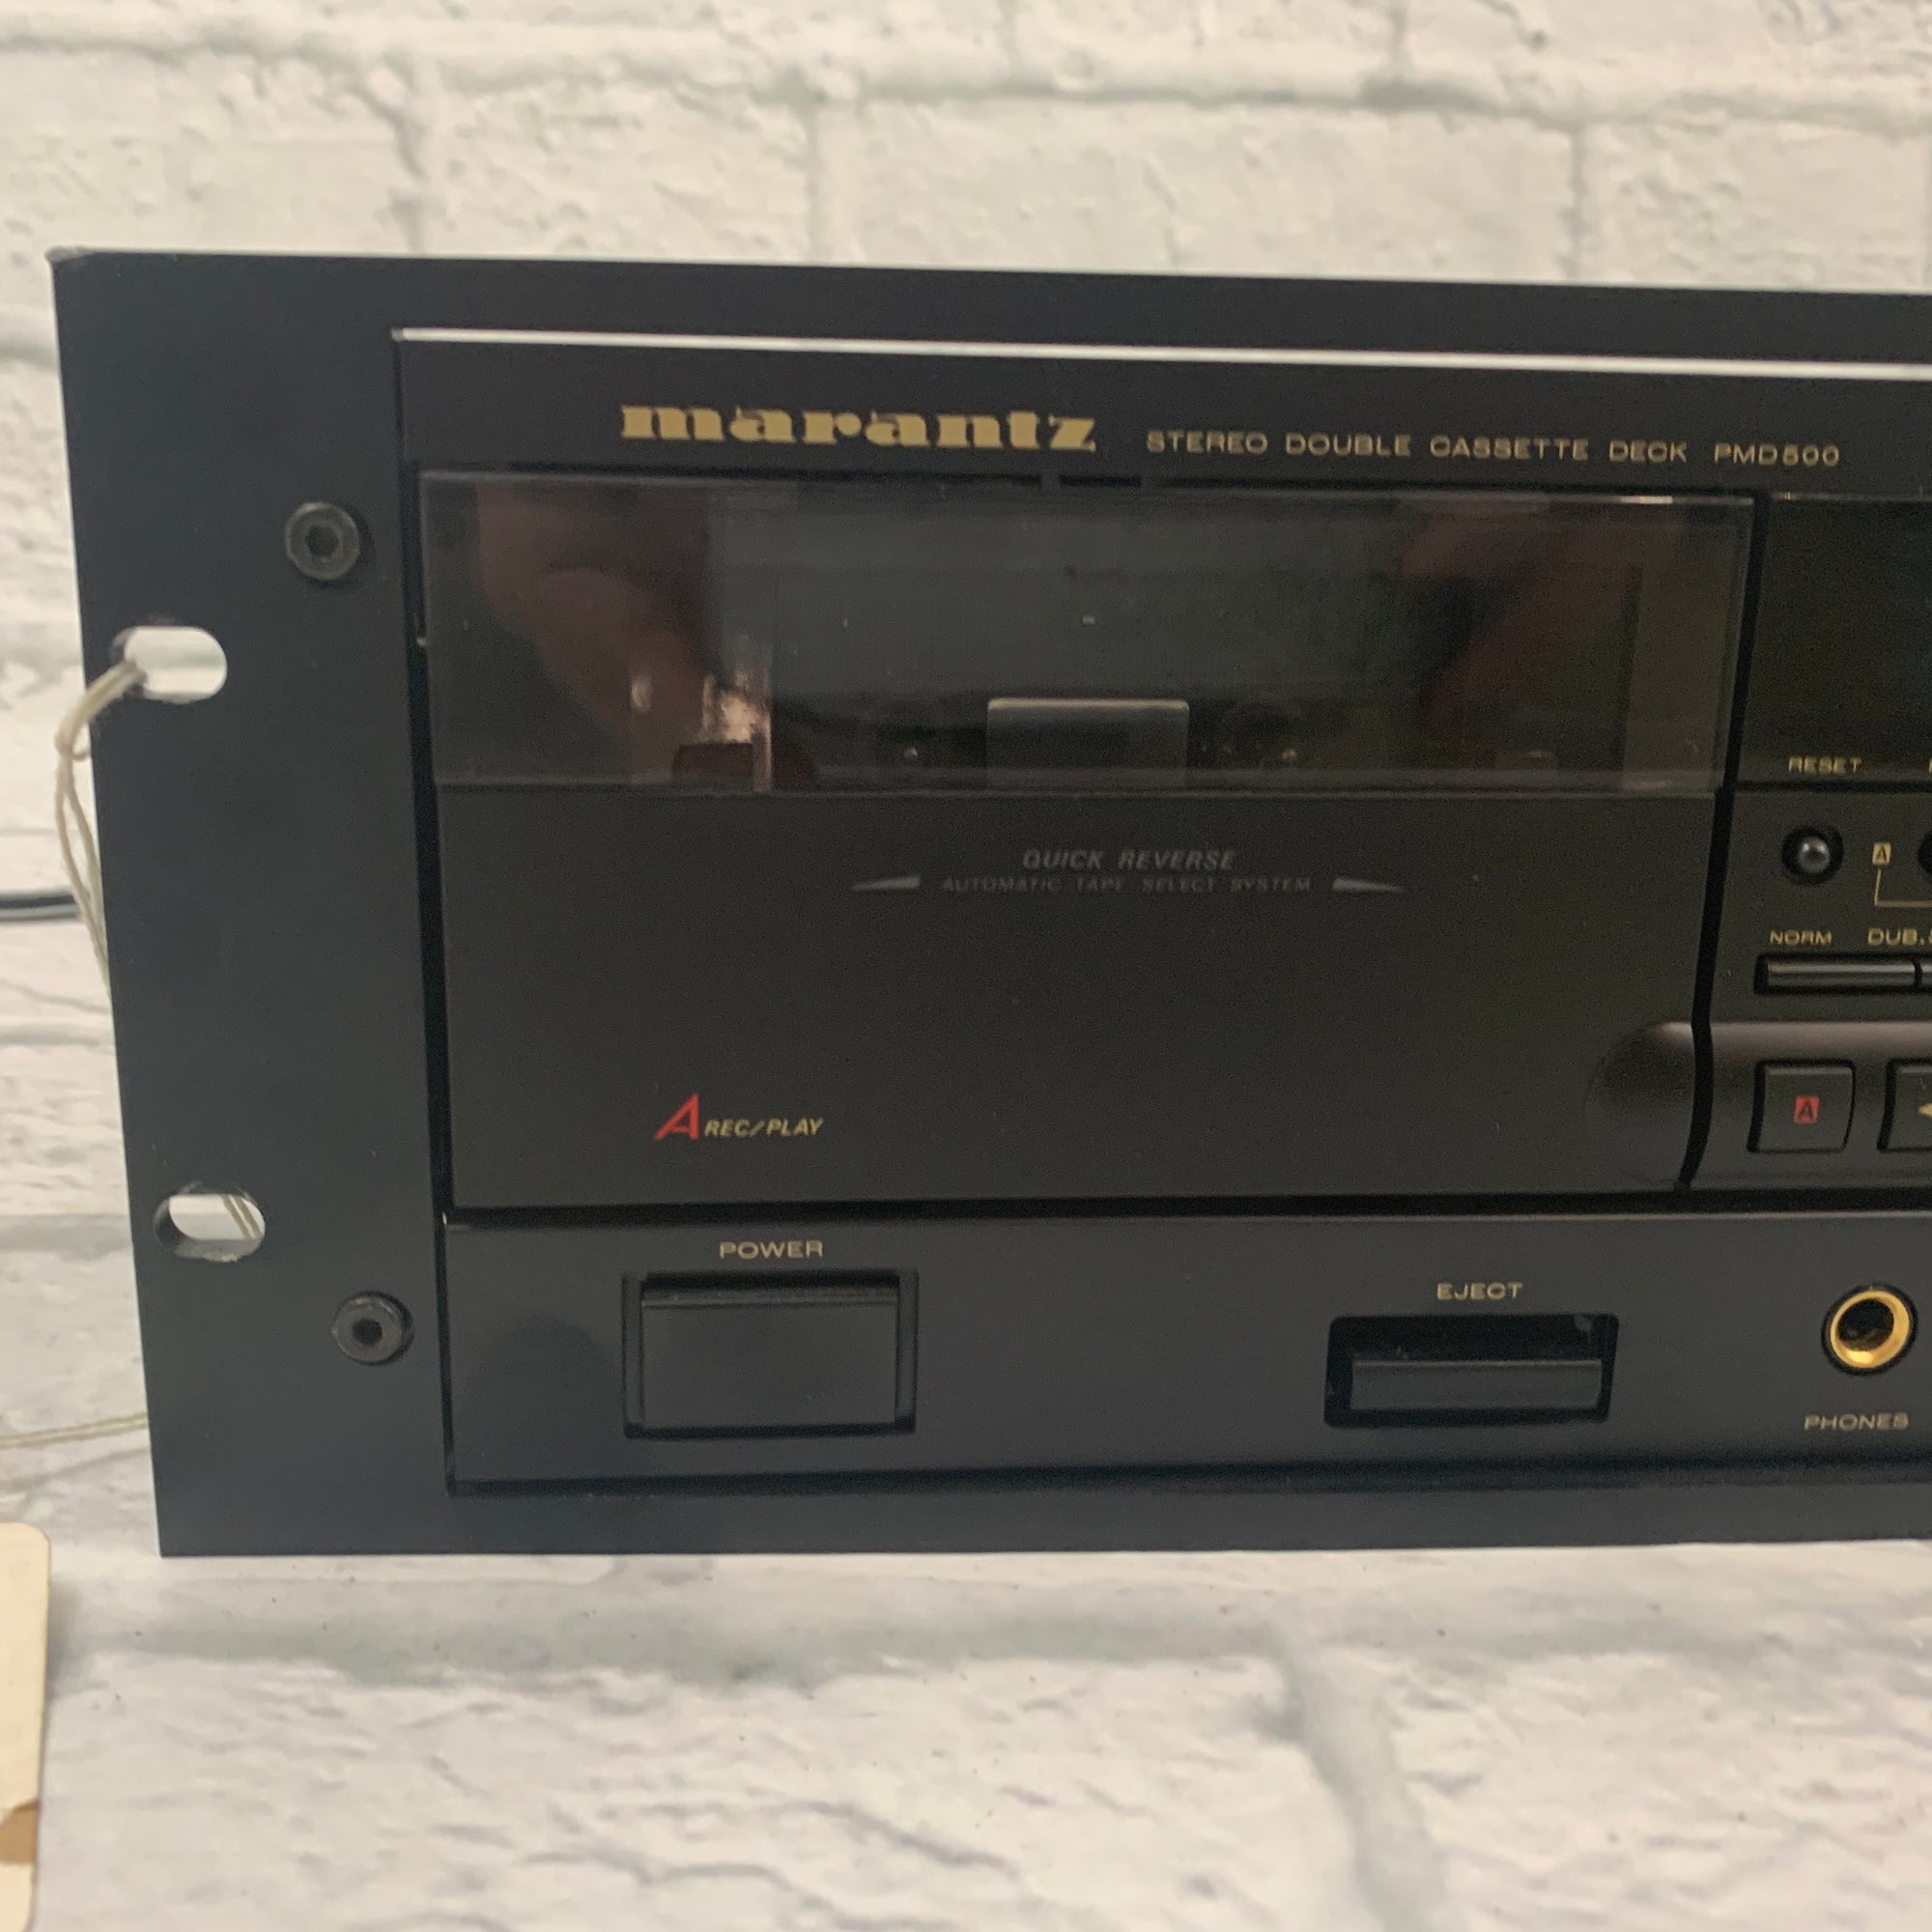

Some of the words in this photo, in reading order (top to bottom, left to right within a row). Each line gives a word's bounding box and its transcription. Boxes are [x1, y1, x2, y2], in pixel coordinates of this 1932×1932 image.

[621, 406, 1096, 451] marantz
[1147, 431, 1268, 455] STEREO
[1285, 433, 1410, 458] DOUBLE
[1430, 435, 1589, 461] CASSETTE
[1608, 440, 1687, 464] DECK
[1713, 443, 1839, 467] PMD500
[1788, 757, 1861, 773] RESET
[1022, 849, 1103, 869] QUICK
[1118, 850, 1235, 871] REVERSE
[942, 876, 1061, 893] AUTOMATIC
[1076, 876, 1125, 893] TAPE
[1142, 876, 1215, 893] SELECT
[1231, 876, 1312, 893] SYSTEM
[1770, 929, 1833, 946] NORM
[655, 1094, 699, 1141] A
[703, 1118, 824, 1138] REC/PLAY
[1796, 1098, 1817, 1122] A
[719, 1240, 823, 1260] POWER
[1436, 1282, 1523, 1300] EJECT
[1804, 1412, 1909, 1431] PHONES
